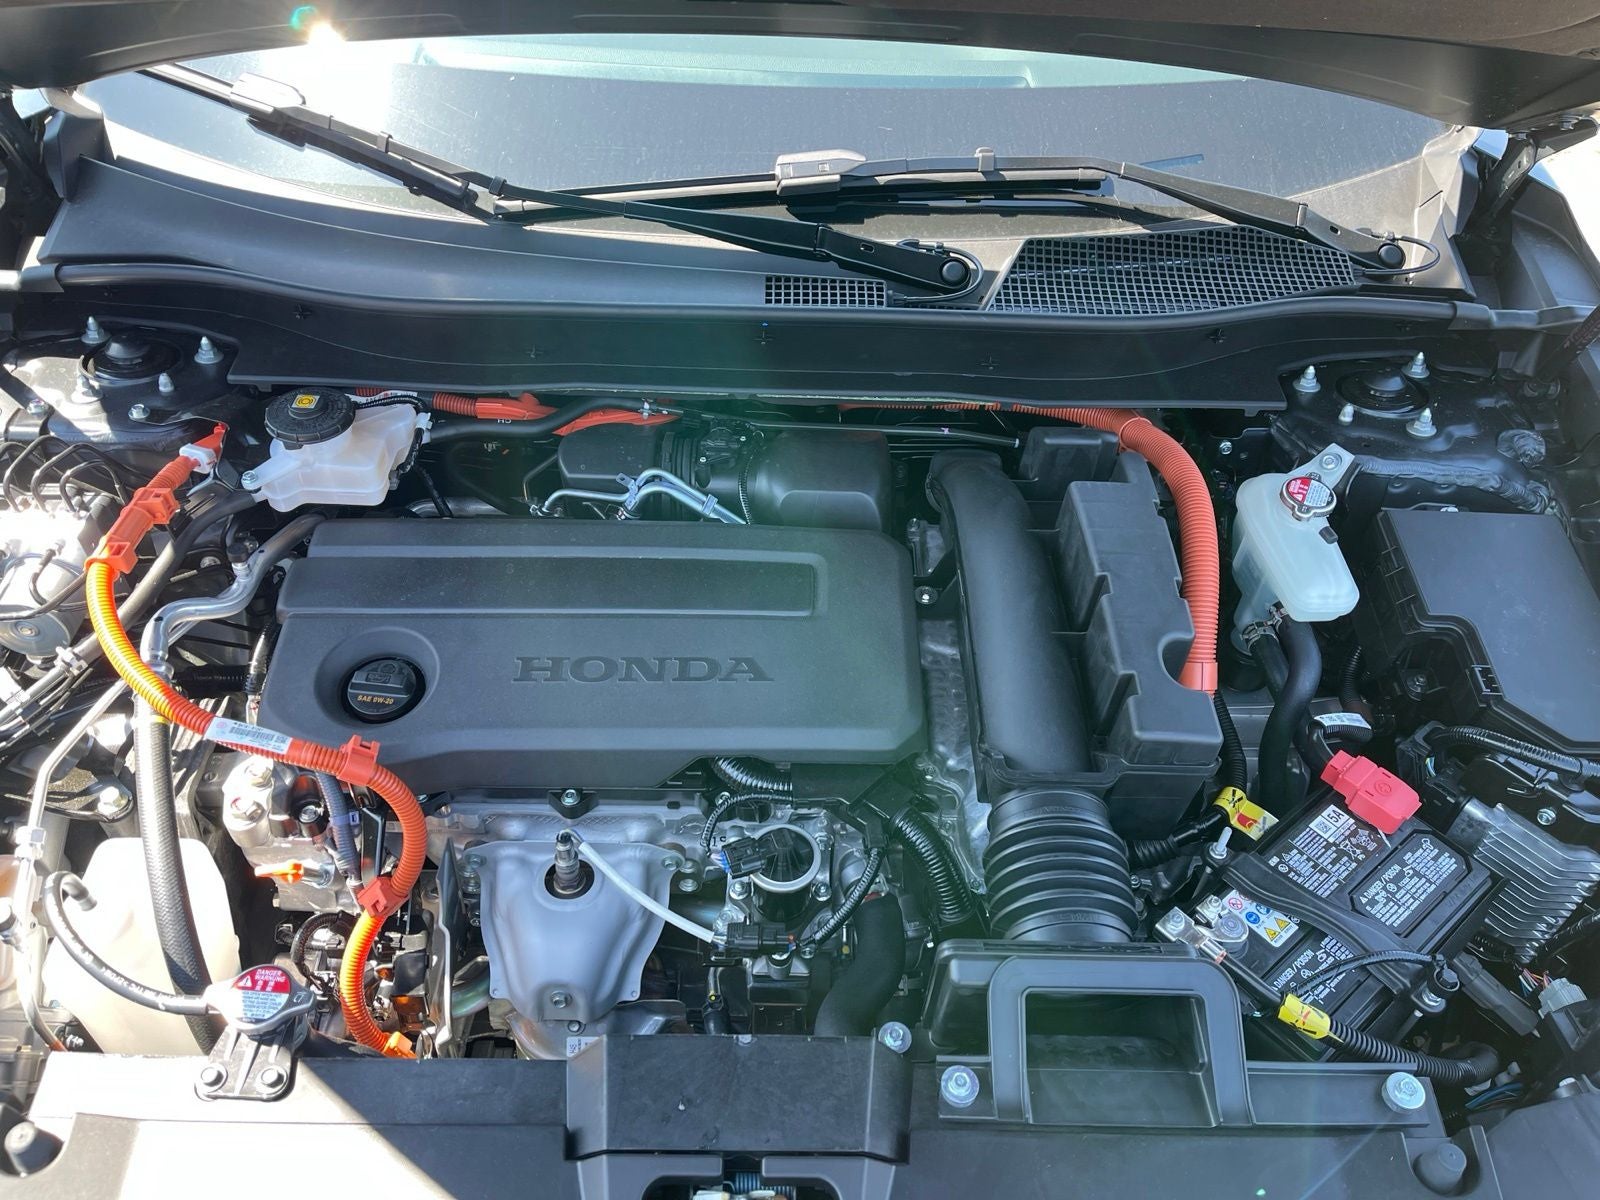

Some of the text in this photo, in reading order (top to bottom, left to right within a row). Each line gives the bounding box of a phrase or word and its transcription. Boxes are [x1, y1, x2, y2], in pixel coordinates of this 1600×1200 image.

[511, 655, 775, 683] HONDA
[357, 694, 394, 705] SAE 0W-20
[1326, 809, 1345, 823] 5A
[256, 968, 283, 977] DANGER
